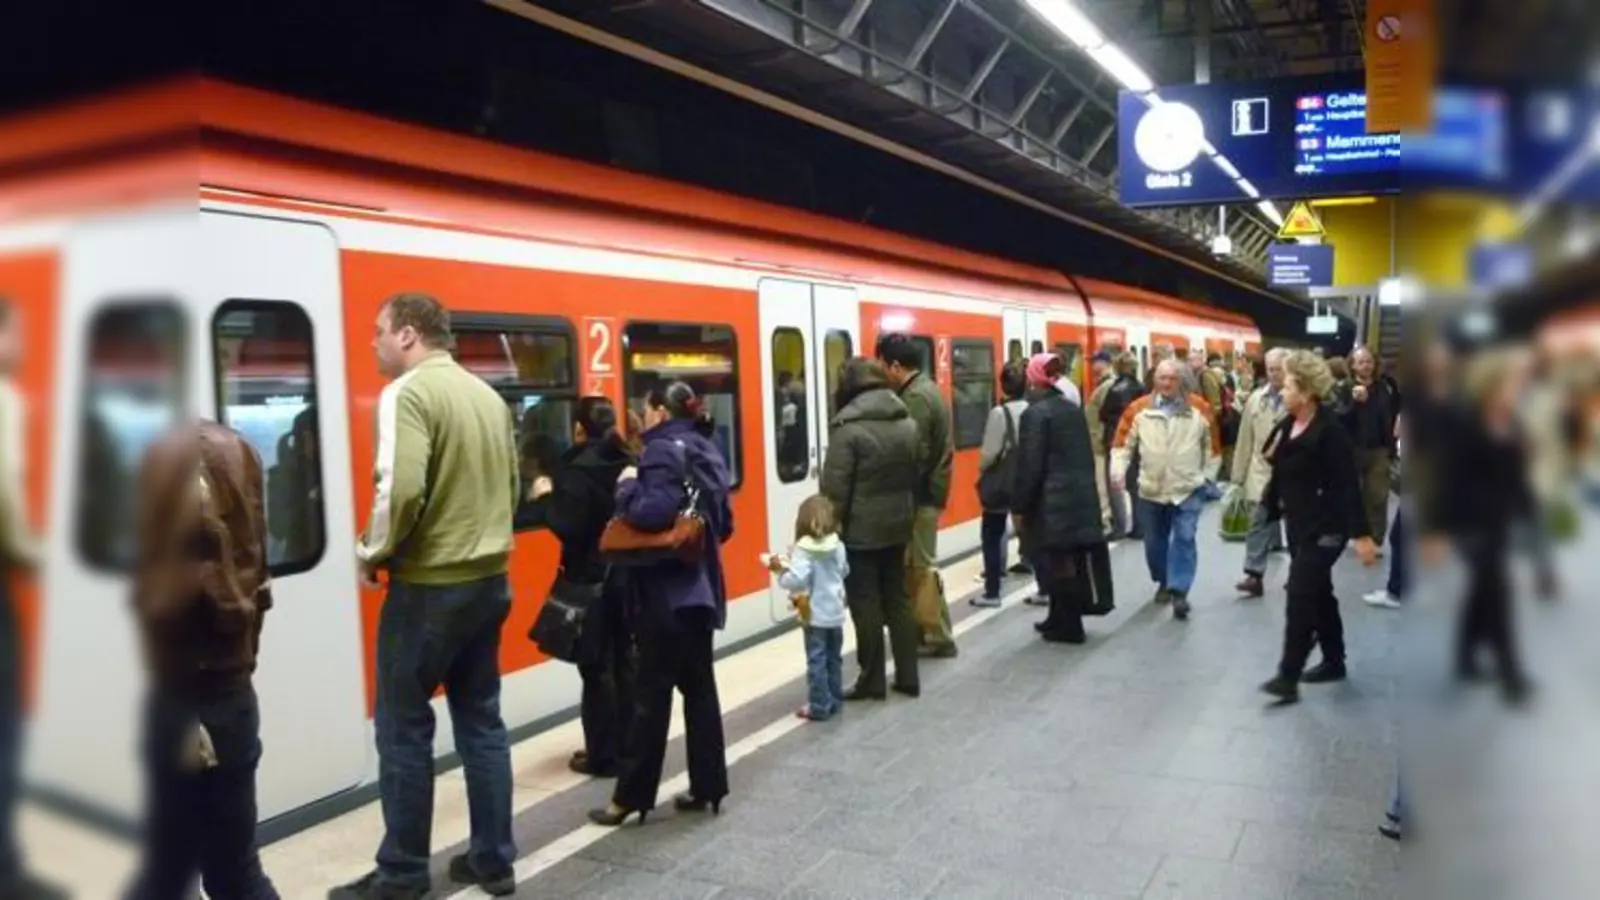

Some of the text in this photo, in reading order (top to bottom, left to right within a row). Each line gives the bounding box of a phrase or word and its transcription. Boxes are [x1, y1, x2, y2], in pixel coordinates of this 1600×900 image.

[1181, 172, 1192, 187] 2
[589, 321, 612, 371] 2
[938, 337, 948, 367] 2
